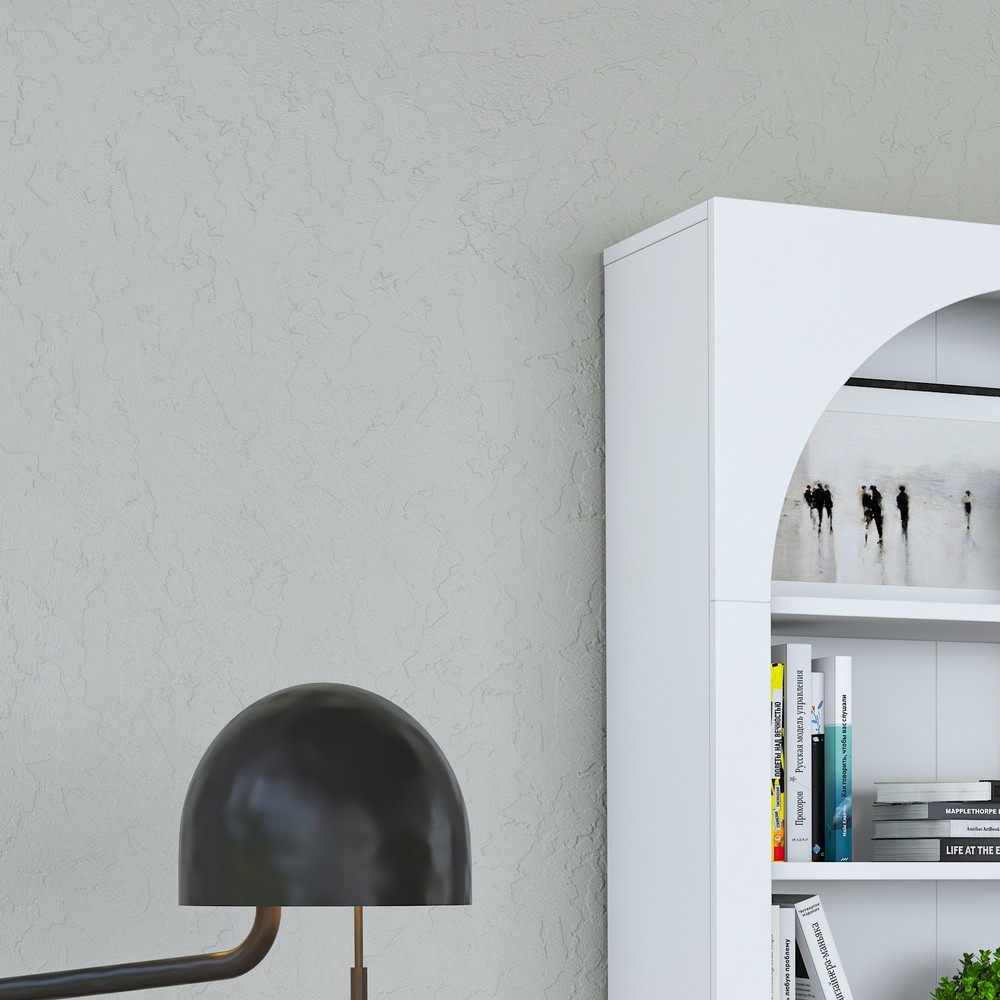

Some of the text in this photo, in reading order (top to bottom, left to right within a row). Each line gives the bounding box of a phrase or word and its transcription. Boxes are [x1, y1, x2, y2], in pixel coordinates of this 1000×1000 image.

[774, 701, 782, 738] ВЕЧНОСТЬЮ
[794, 670, 806, 773] Русская модель управления
[774, 738, 783, 751] НАД
[840, 734, 848, 754] чтобы
[774, 752, 782, 778] ПОЛЕТЫ
[841, 754, 850, 785] говорить,
[840, 786, 848, 798] Как
[794, 791, 806, 826] Прохоров
[946, 846, 964, 855] LIFE
[964, 846, 976, 855] AT
[977, 846, 994, 855] THE
[784, 938, 792, 972] проблему
[784, 972, 792, 996] любую
